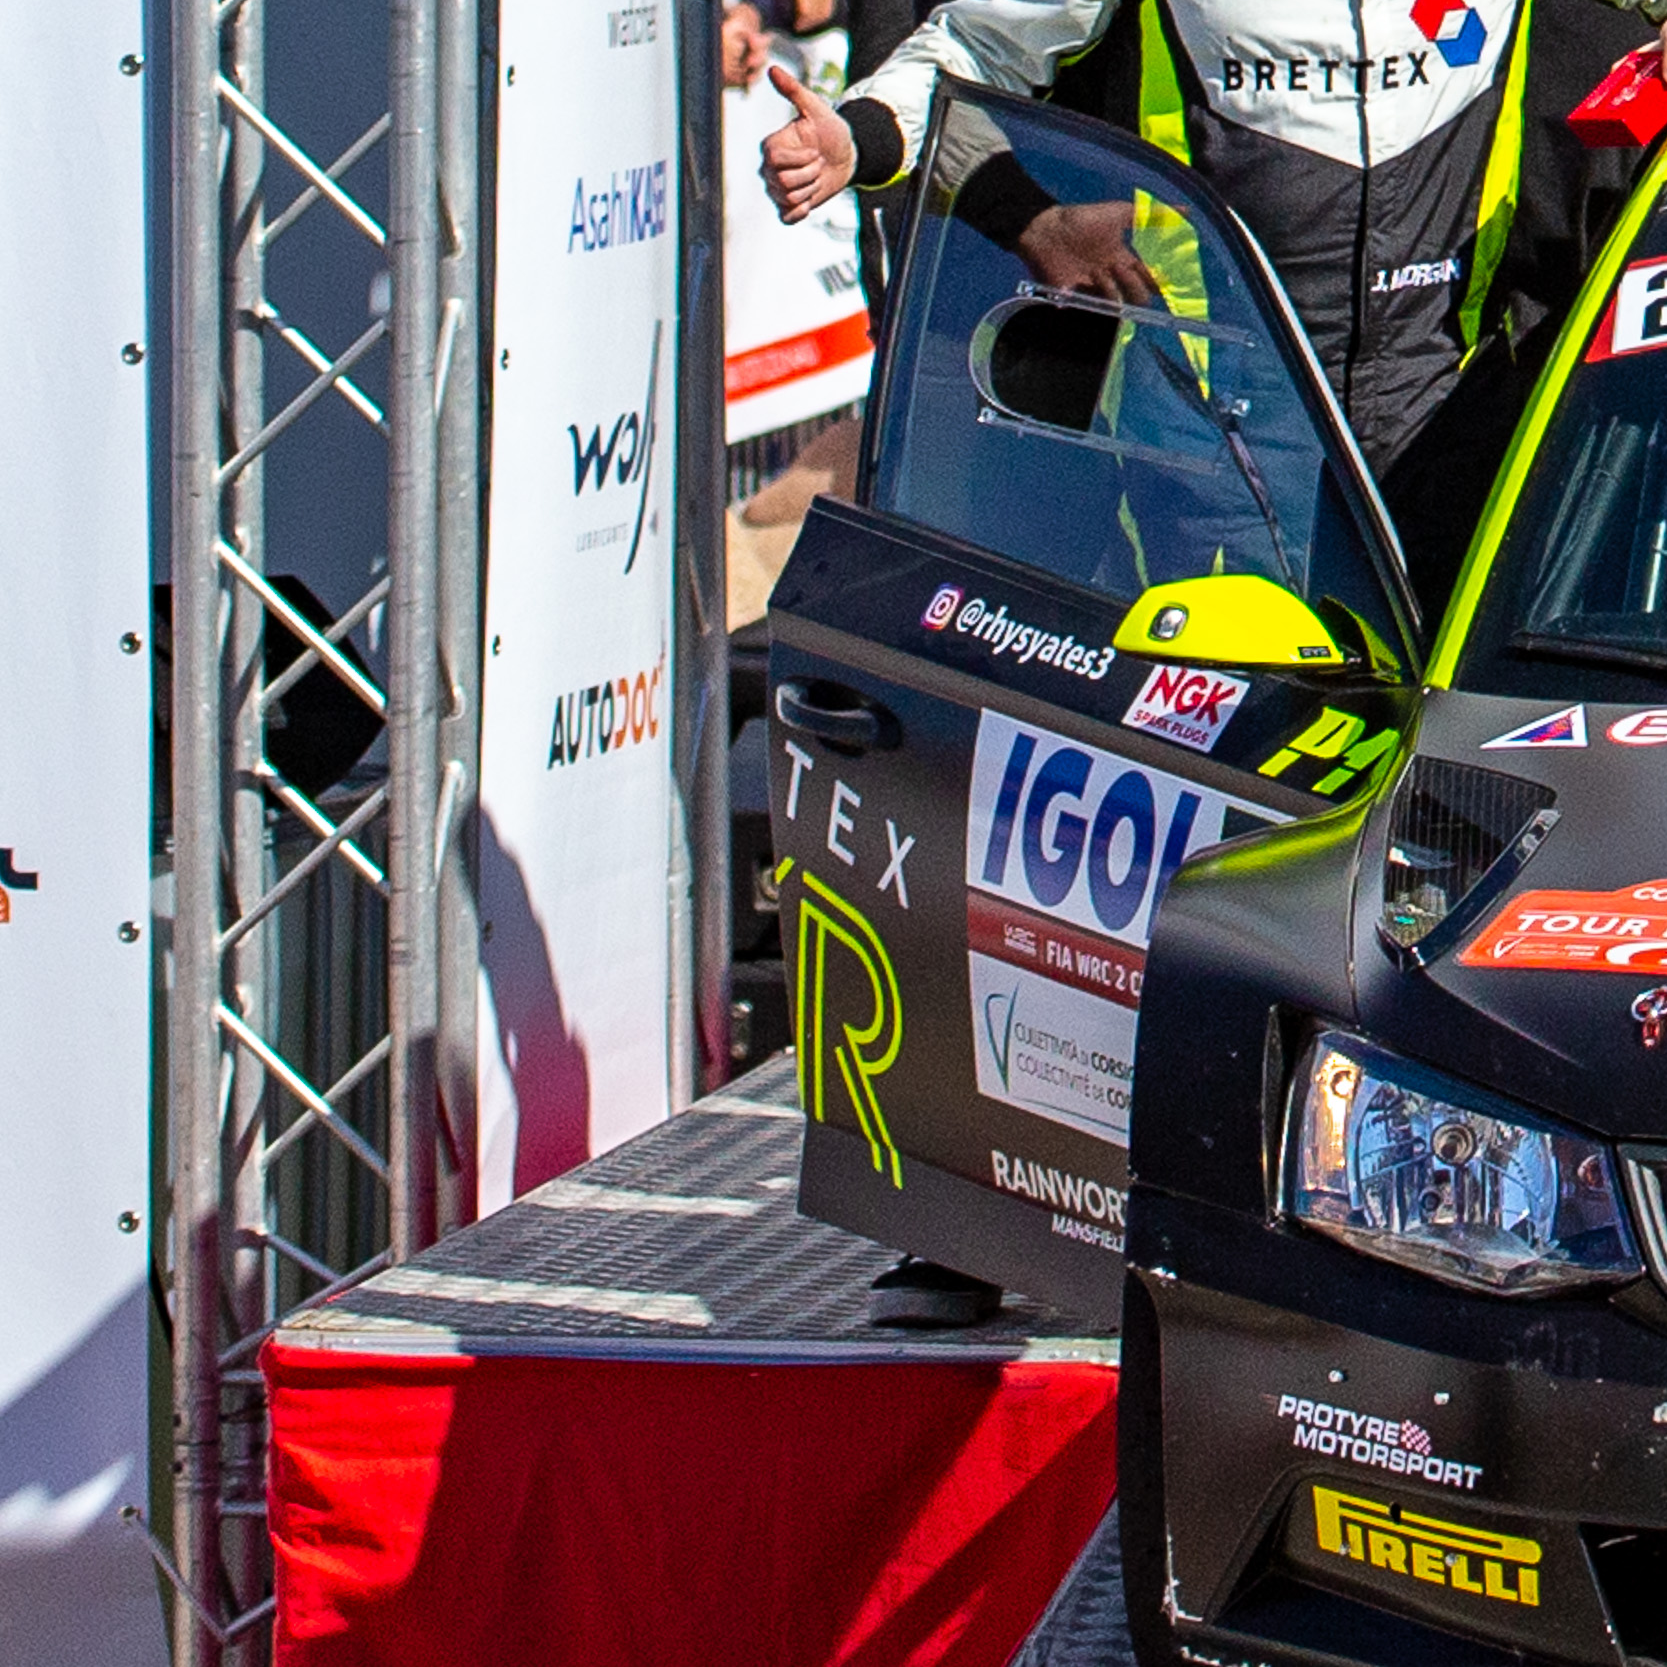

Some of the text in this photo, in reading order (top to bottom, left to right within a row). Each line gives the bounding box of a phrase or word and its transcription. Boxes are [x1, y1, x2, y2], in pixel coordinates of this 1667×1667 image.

[1221, 50, 1431, 94] BRETTEX
[955, 597, 1116, 681] @rhysyates3
[1142, 666, 1239, 726] NGK
[1517, 913, 1649, 935] TOUR
[1047, 939, 1073, 973] FIA
[1077, 953, 1112, 986] WRC
[1115, 966, 1129, 991] 2
[1276, 1393, 1403, 1447] PROTYRE
[1293, 1423, 1484, 1490] MOTORSPORT
[1312, 1485, 1543, 1607] PIRELLI
